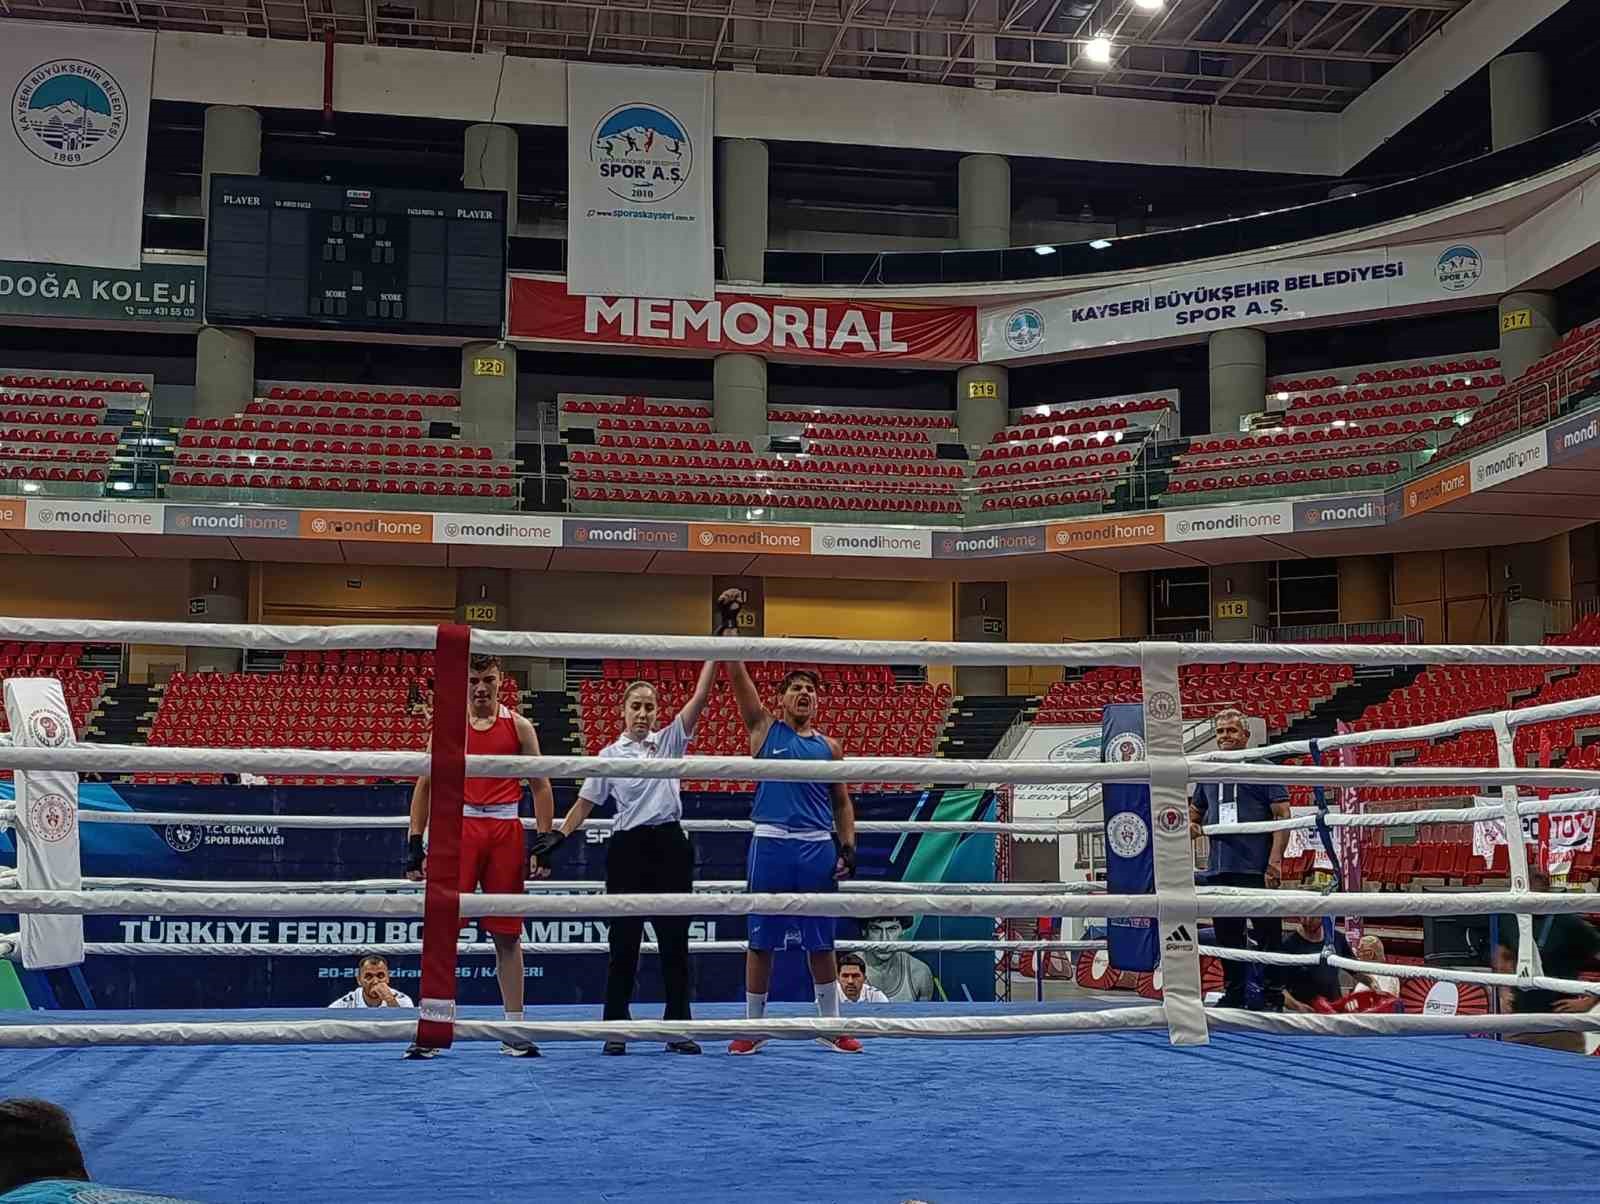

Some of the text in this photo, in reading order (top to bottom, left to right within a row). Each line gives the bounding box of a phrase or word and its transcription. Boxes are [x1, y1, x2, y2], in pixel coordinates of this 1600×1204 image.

[53, 152, 81, 162] 1869
[600, 164, 684, 184] SPOR A.Ş.
[223, 194, 261, 206] PLAYER
[631, 189, 654, 198] 2010
[457, 208, 494, 220] PLAYER
[0, 272, 81, 299] DOĞA
[325, 290, 347, 298] SCORE
[380, 293, 402, 301] SCORE
[1176, 299, 1289, 325] SPOR A.Ş.
[584, 297, 908, 352] MEMORIAL
[1503, 313, 1527, 328] 217
[479, 361, 502, 373] 220
[971, 384, 994, 395] 219
[1565, 419, 1600, 448] mondi
[1485, 445, 1541, 477] mondihome
[55, 508, 152, 525] mondihome
[1321, 501, 1394, 521] mondiho
[192, 513, 288, 530] mondihome
[327, 519, 423, 535] mondihome
[1191, 513, 1281, 531] mondihome
[461, 523, 551, 538] mondihome
[589, 528, 678, 543] mondihome
[1071, 523, 1155, 541] mondihome
[715, 531, 801, 546] mondihome
[837, 536, 921, 550] mondihome
[955, 534, 1037, 551] mondihome
[470, 607, 493, 619] 120
[1221, 604, 1244, 615] 118
[738, 614, 754, 625] 19
[206, 825, 222, 834] T.C.
[266, 825, 278, 834] VE
[205, 835, 285, 845] SPOR BAKANLIĞI
